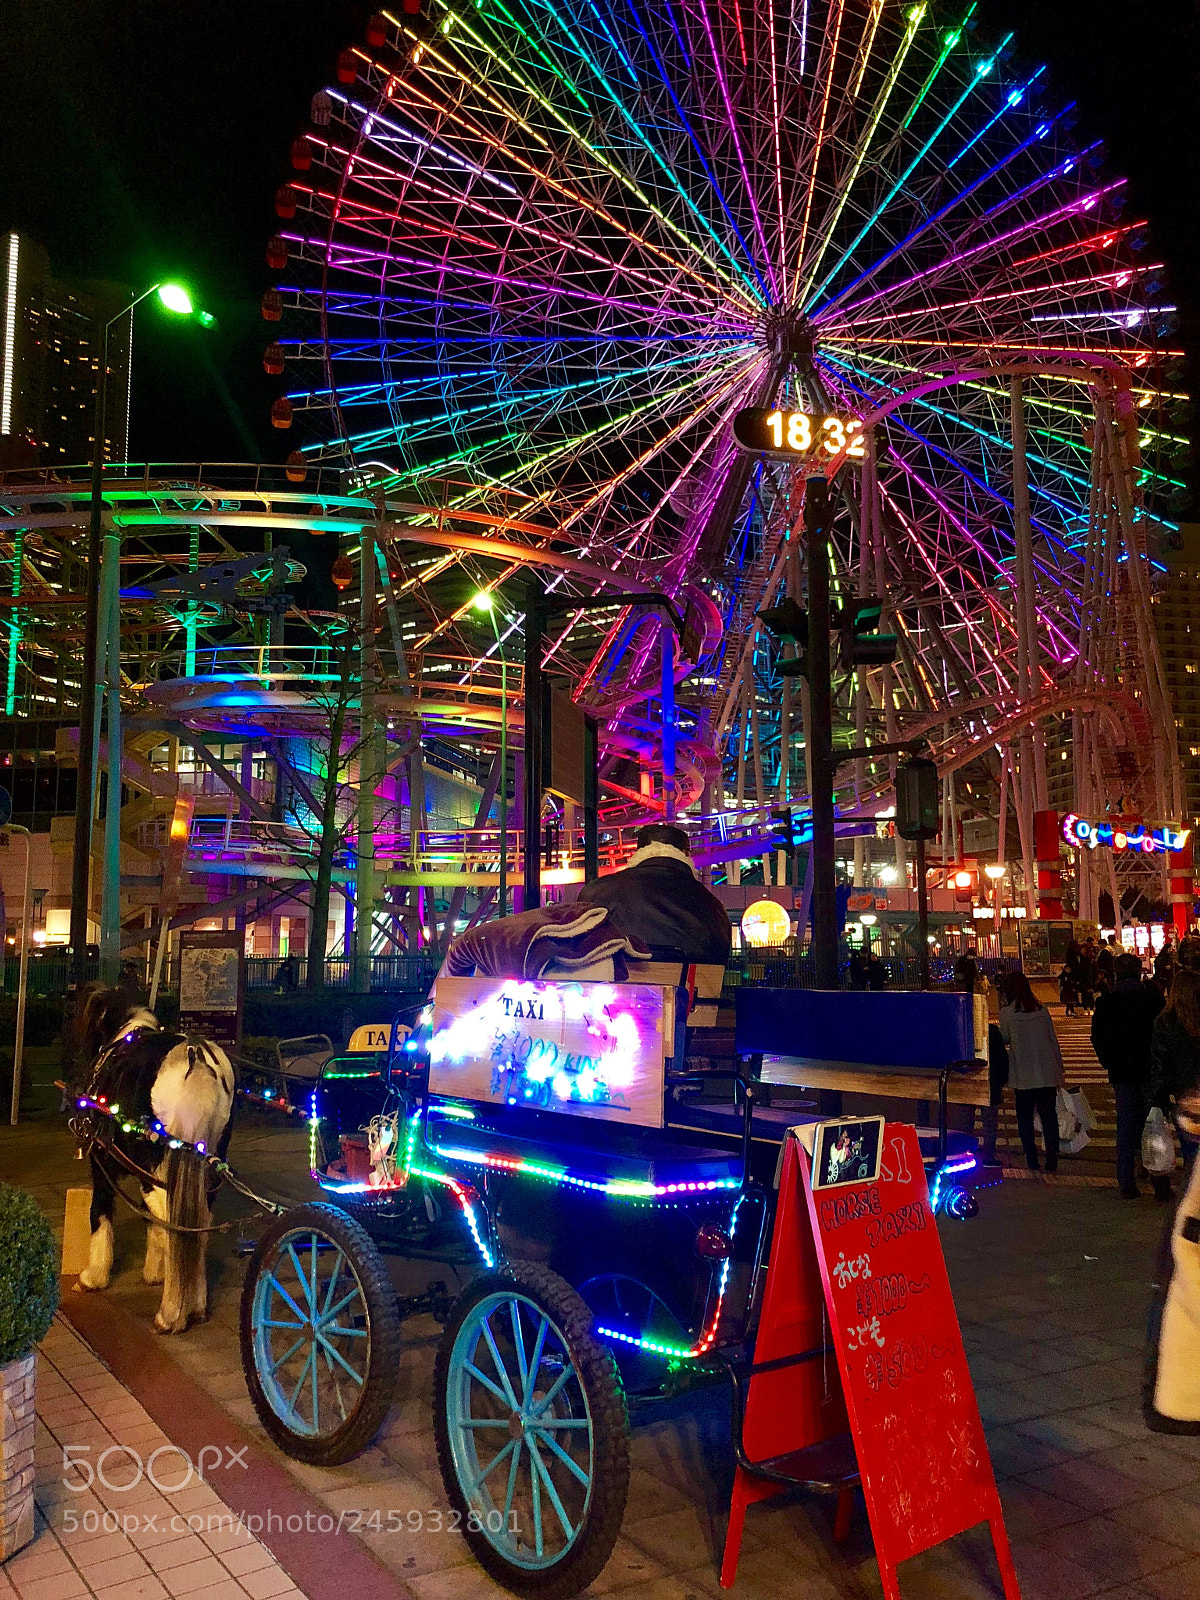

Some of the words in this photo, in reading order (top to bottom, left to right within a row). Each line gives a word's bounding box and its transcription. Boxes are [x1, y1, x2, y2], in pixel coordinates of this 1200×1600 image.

[766, 411, 811, 450] 18
[823, 418, 865, 456] 32
[503, 997, 544, 1020] TAXI
[820, 1187, 882, 1232] HORSE
[866, 1202, 926, 1248] TAXI
[833, 1252, 872, 1289] おとな
[847, 1316, 886, 1350] こども
